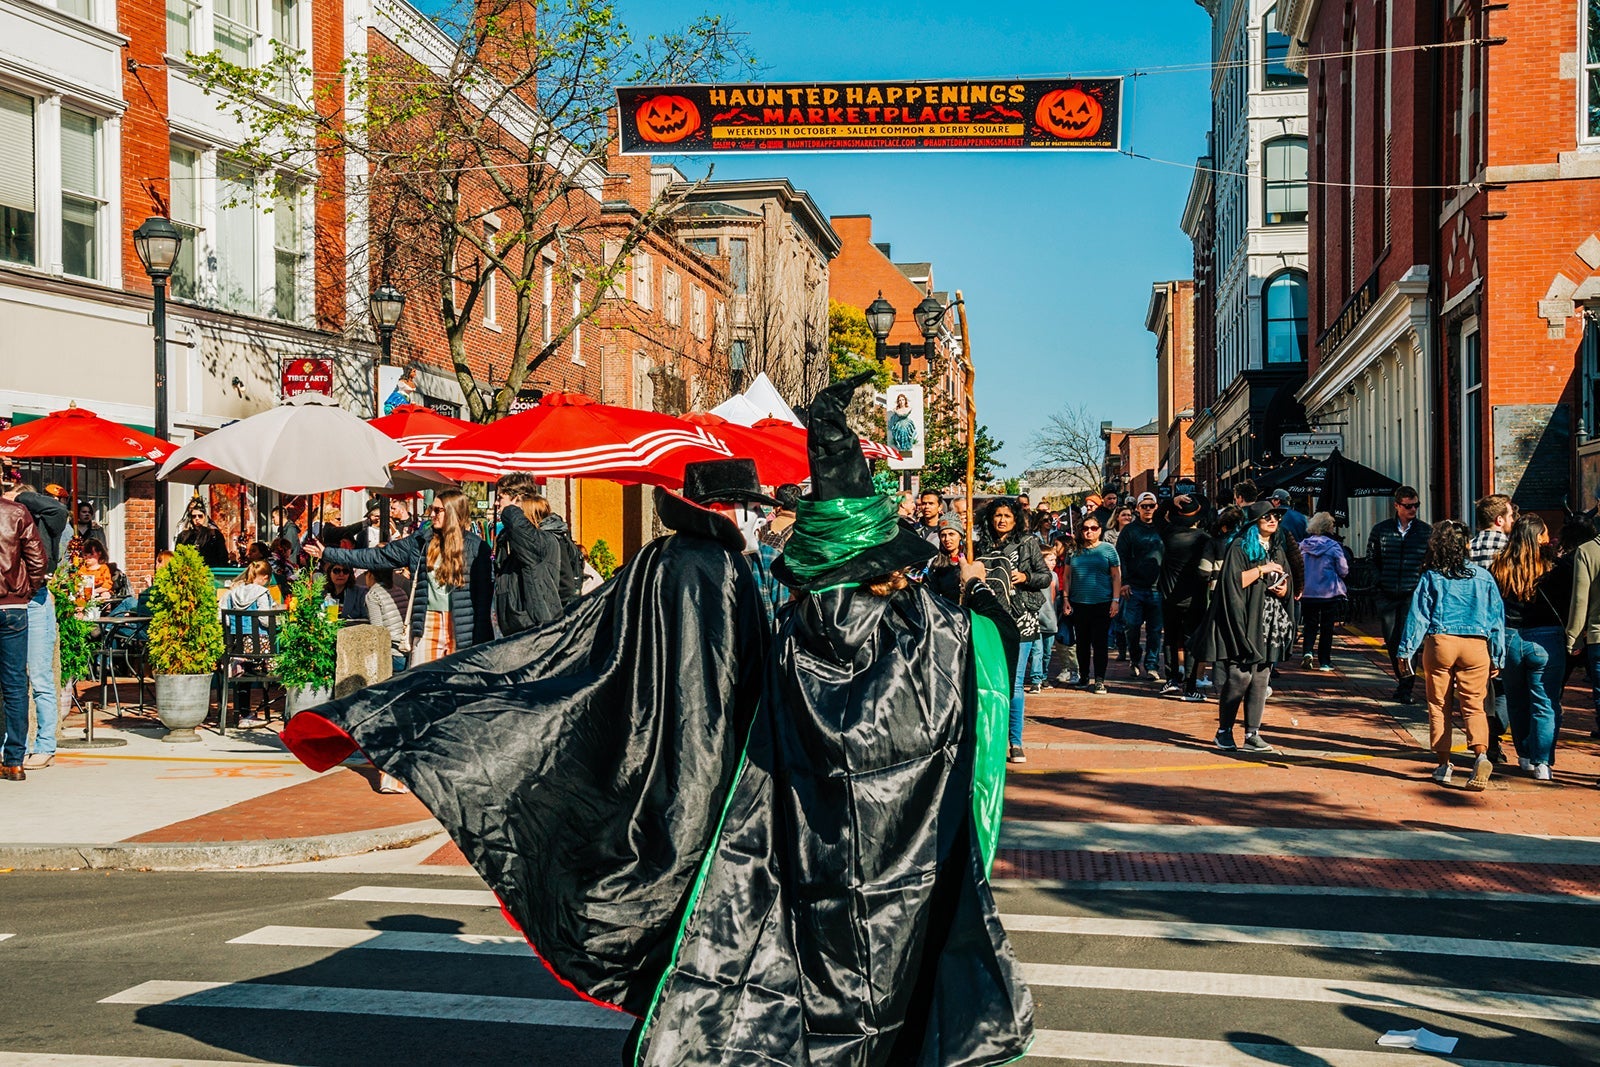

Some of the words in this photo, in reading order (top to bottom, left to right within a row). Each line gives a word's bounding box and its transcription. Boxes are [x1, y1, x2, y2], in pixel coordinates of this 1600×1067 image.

[709, 88, 839, 106] HAUNTED
[845, 84, 1025, 104] HAPPENINGS
[763, 106, 972, 123] MARKETPLACE
[727, 127, 777, 136] WEEKENDS
[780, 127, 790, 135] IN
[794, 127, 837, 135] OCTOBER
[847, 126, 877, 134] SALEM
[881, 126, 924, 134] COMMON
[940, 125, 969, 133] DERBY
[973, 125, 1010, 133] SQUARE
[787, 139, 916, 149] HAUNTEDHAPPENINGSMARKETPLACE.COM
